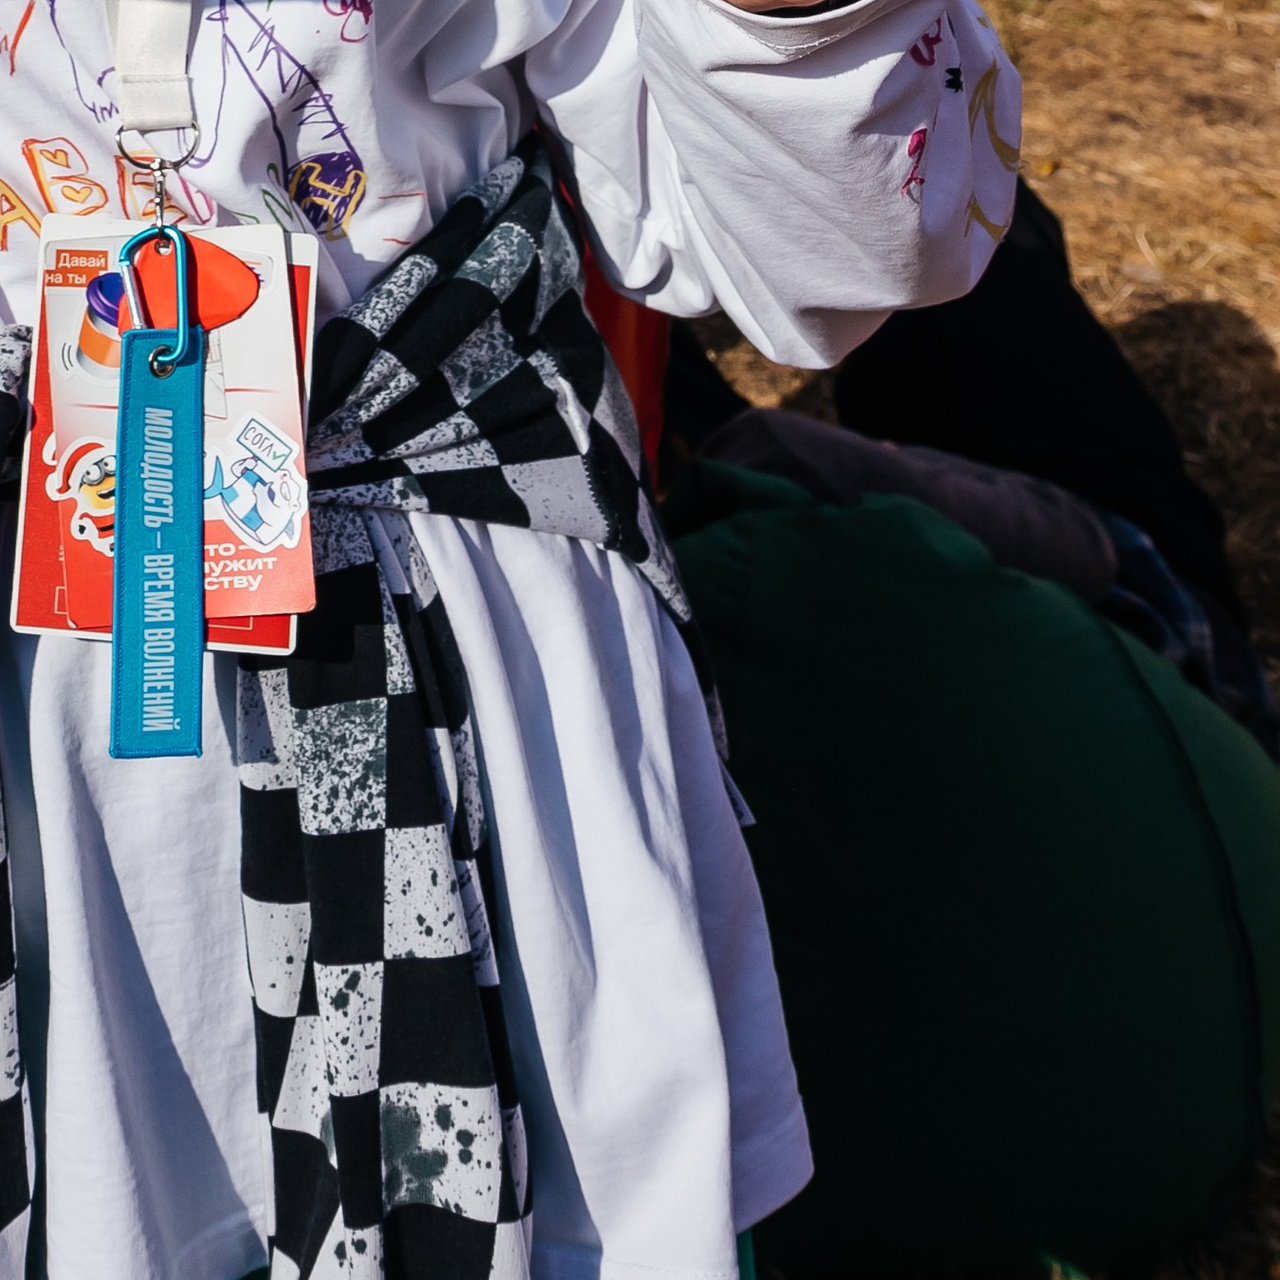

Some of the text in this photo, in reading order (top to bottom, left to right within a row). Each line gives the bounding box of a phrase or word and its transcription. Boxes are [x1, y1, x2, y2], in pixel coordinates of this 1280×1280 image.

[44, 273, 87, 284] на ты
[57, 252, 106, 268] Давай
[139, 406, 175, 528] МОЛОДОСТЬ
[142, 553, 176, 623] ВРЕМЯ
[141, 628, 181, 732] ВОЛНЕНИЙ
